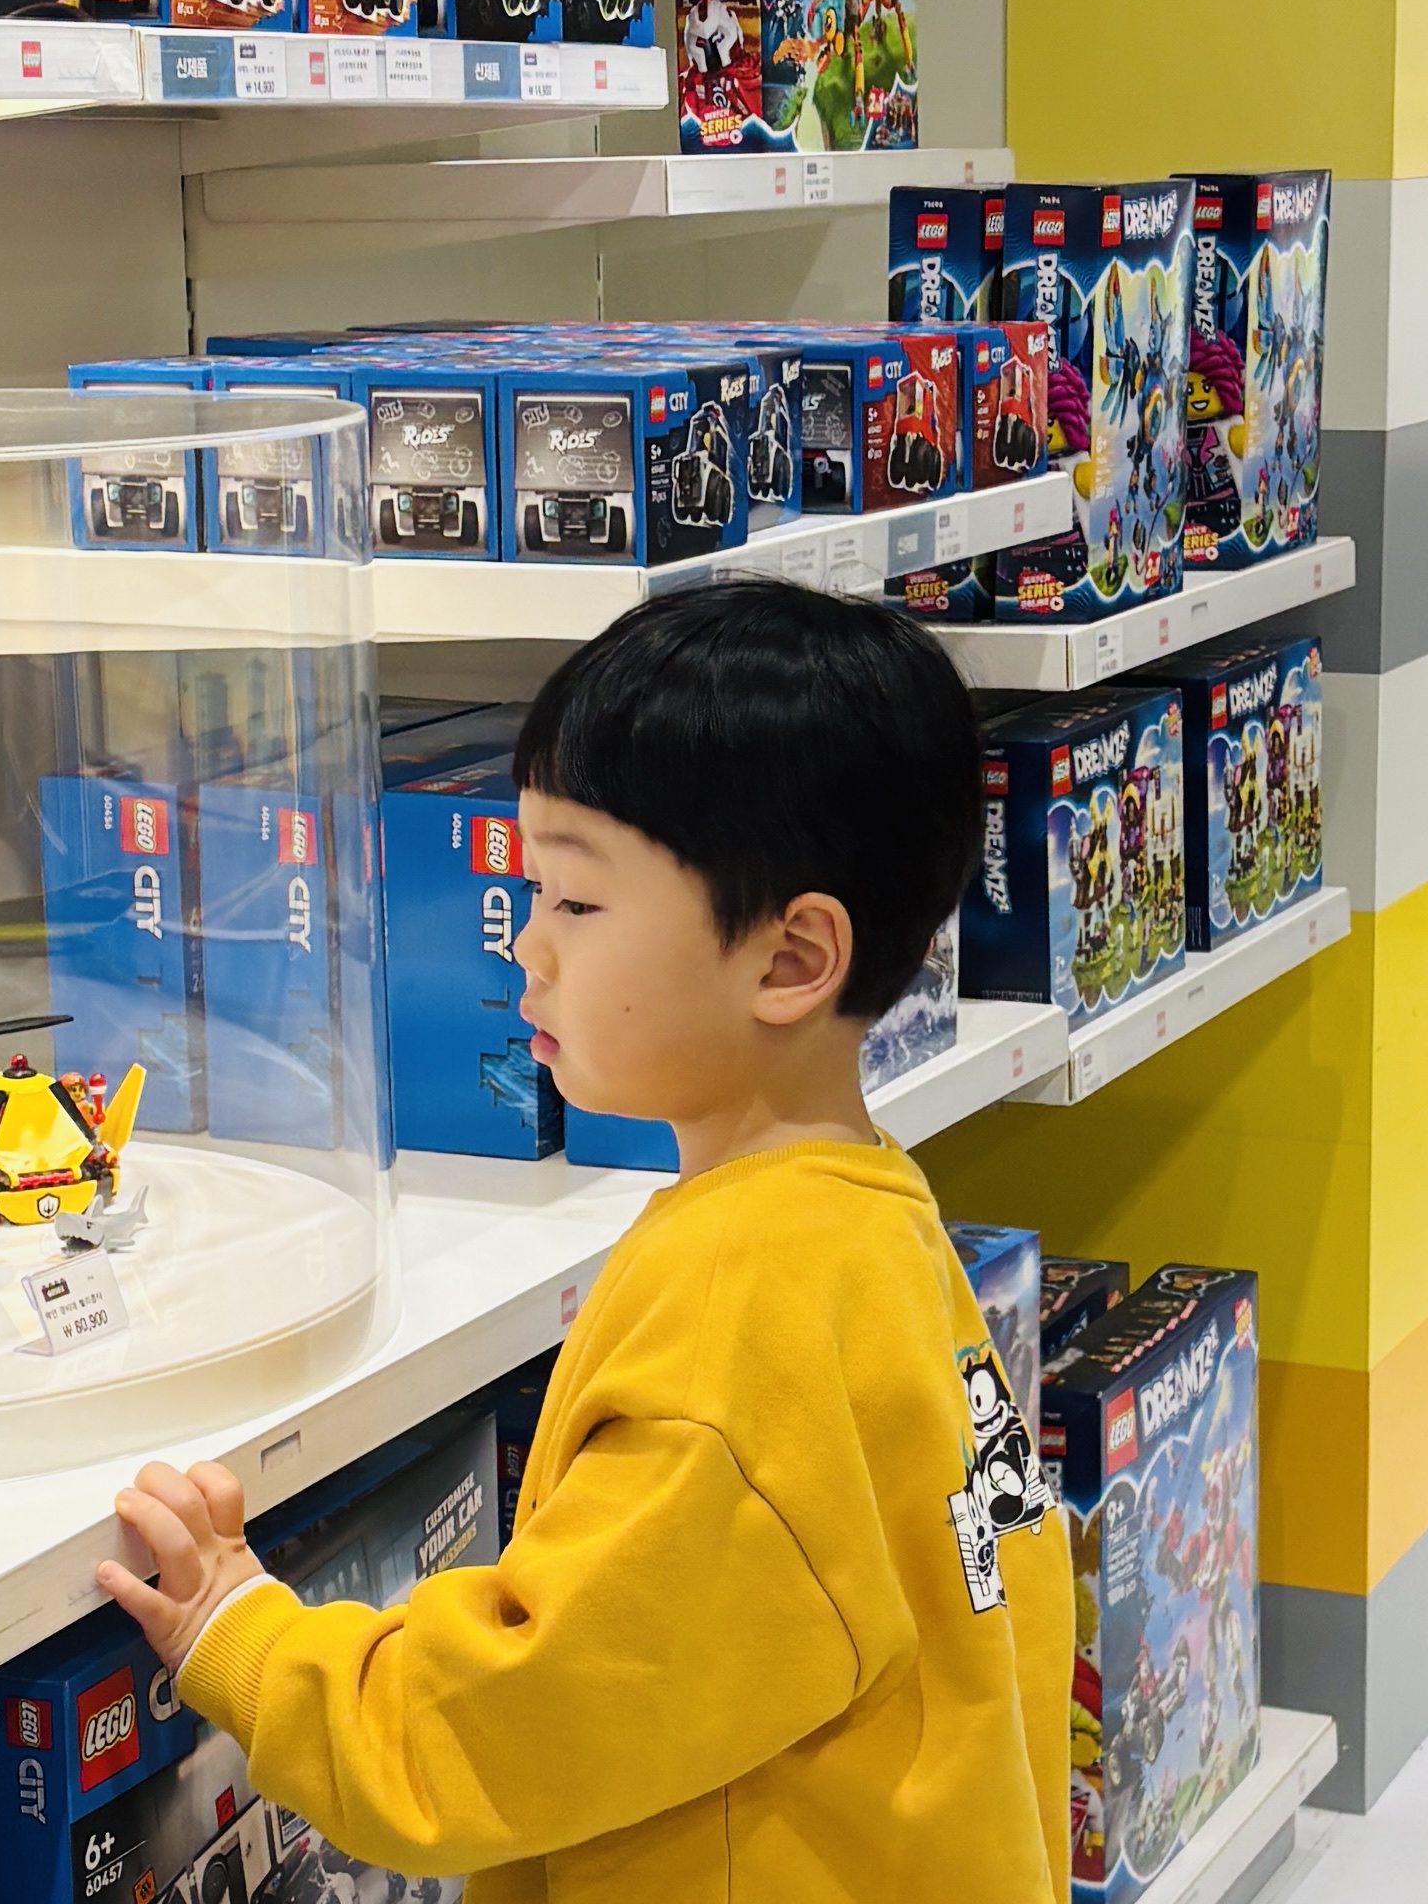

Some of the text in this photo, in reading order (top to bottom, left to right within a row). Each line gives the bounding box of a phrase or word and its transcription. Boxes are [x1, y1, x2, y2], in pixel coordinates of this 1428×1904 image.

[699, 114, 743, 137] SERIES
[132, 799, 163, 941] LEGO CITY
[481, 817, 515, 965] LEGO CITY
[287, 875, 312, 954] CITY
[74, 1309, 109, 1336] 60,900
[1107, 1415, 1137, 1454] LEGO
[419, 1484, 484, 1569] YOUR CAR
[424, 1471, 475, 1534] CUSTOMISE
[81, 1694, 138, 1762] LEGO
[16, 1700, 47, 1825] LEGO CITY
[83, 1830, 117, 1872] 6+
[84, 1859, 124, 1898] 60457
